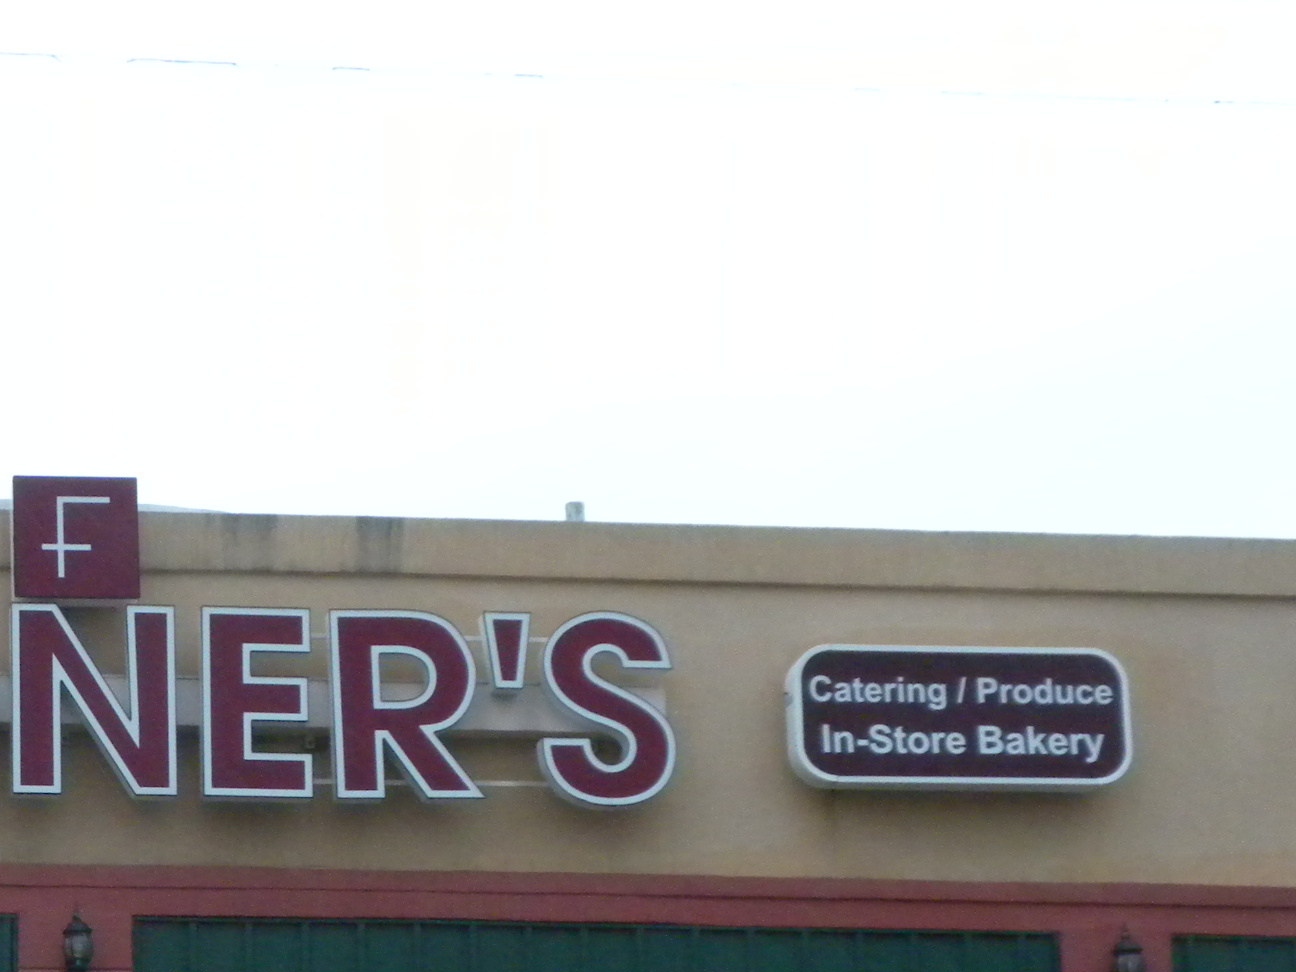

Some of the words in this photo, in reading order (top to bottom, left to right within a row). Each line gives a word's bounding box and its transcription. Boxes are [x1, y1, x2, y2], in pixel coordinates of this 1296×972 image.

[41, 496, 111, 578] F
[808, 675, 947, 710] Catering
[957, 676, 968, 704] /
[976, 677, 1114, 705] Produce
[821, 723, 967, 754] In-Store
[976, 725, 1105, 763] Bakery
